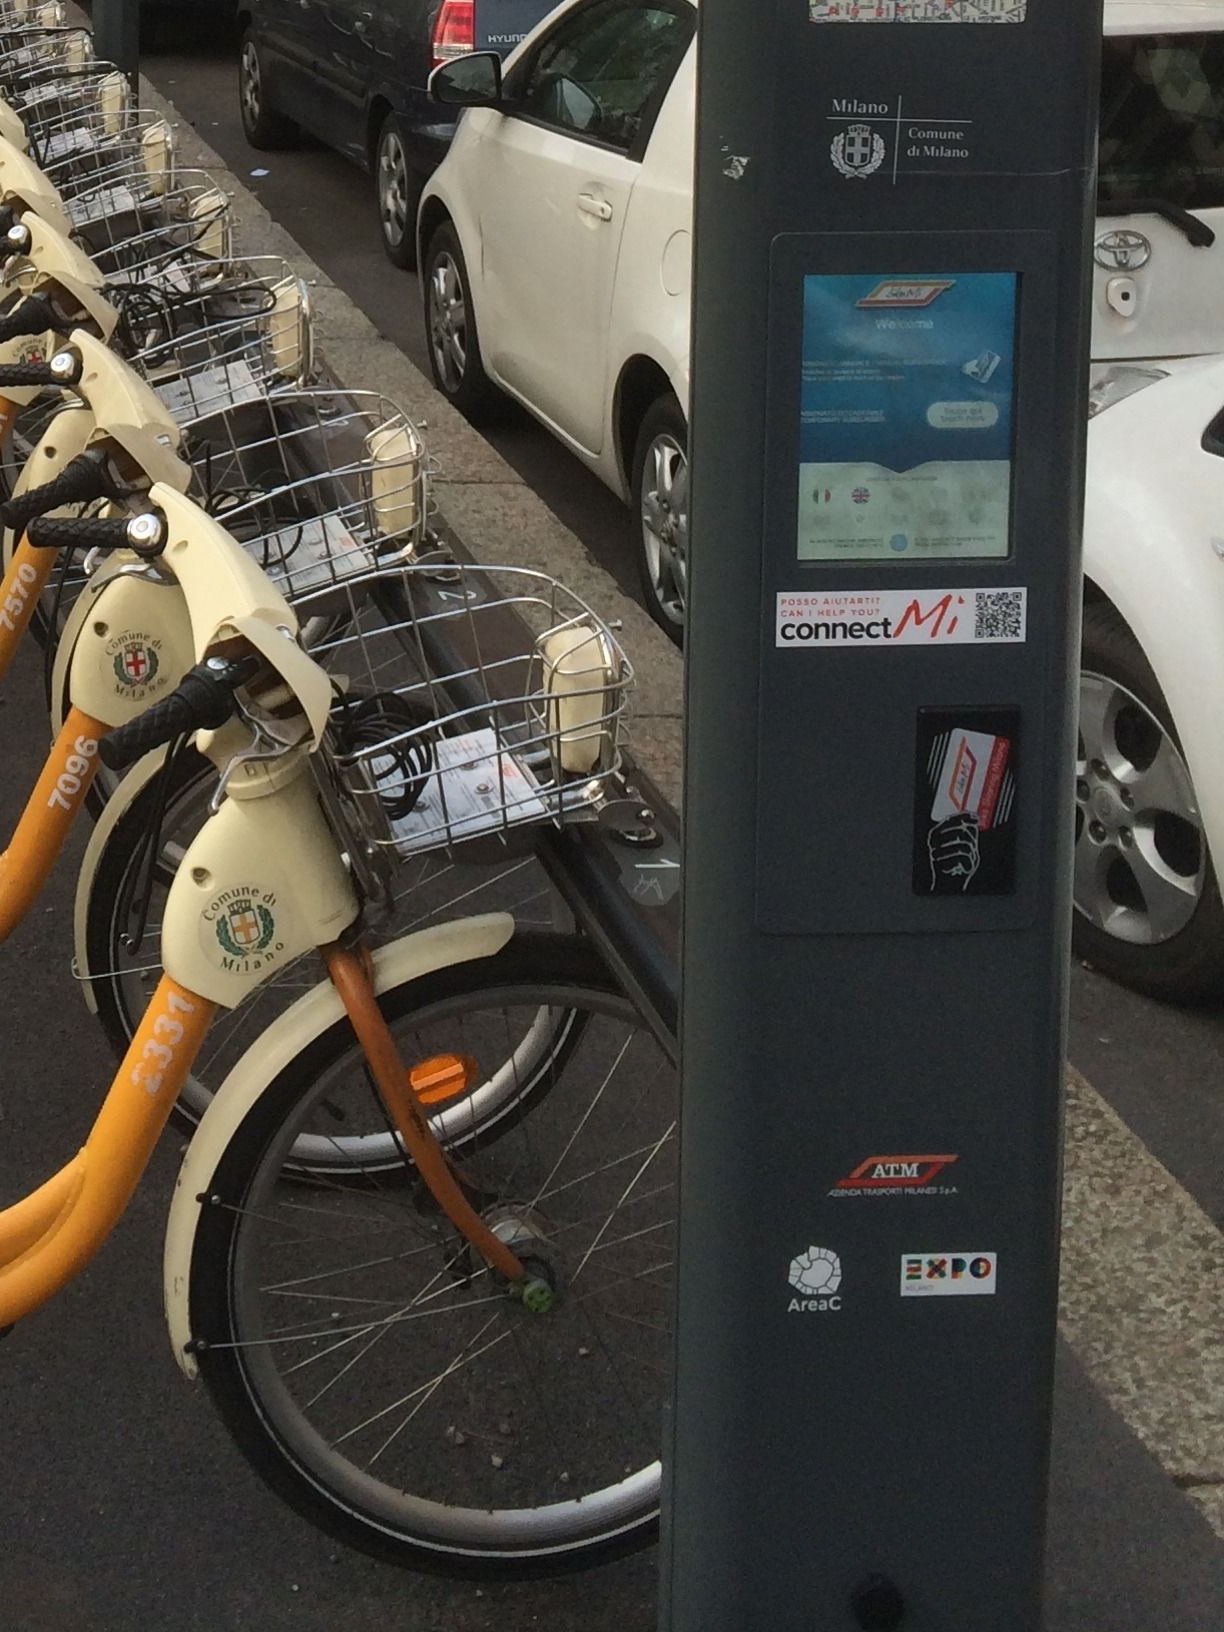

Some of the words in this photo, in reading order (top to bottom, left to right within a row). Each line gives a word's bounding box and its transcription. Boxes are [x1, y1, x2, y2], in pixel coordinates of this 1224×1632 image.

[832, 98, 889, 115] Milano
[908, 127, 964, 141] Comune
[907, 146, 920, 157] di
[923, 146, 969, 158] Milano
[781, 597, 818, 606] POSSO
[780, 609, 804, 617] CAN
[817, 608, 846, 617] HELP
[851, 608, 881, 616] YOU?
[47, 734, 99, 811] 7096
[201, 886, 260, 921] Comune
[262, 893, 277, 907] di
[219, 942, 285, 972] Milano
[131, 991, 195, 1097] 2331
[871, 1162, 920, 1179] ATM
[906, 1257, 992, 1281] EXPO
